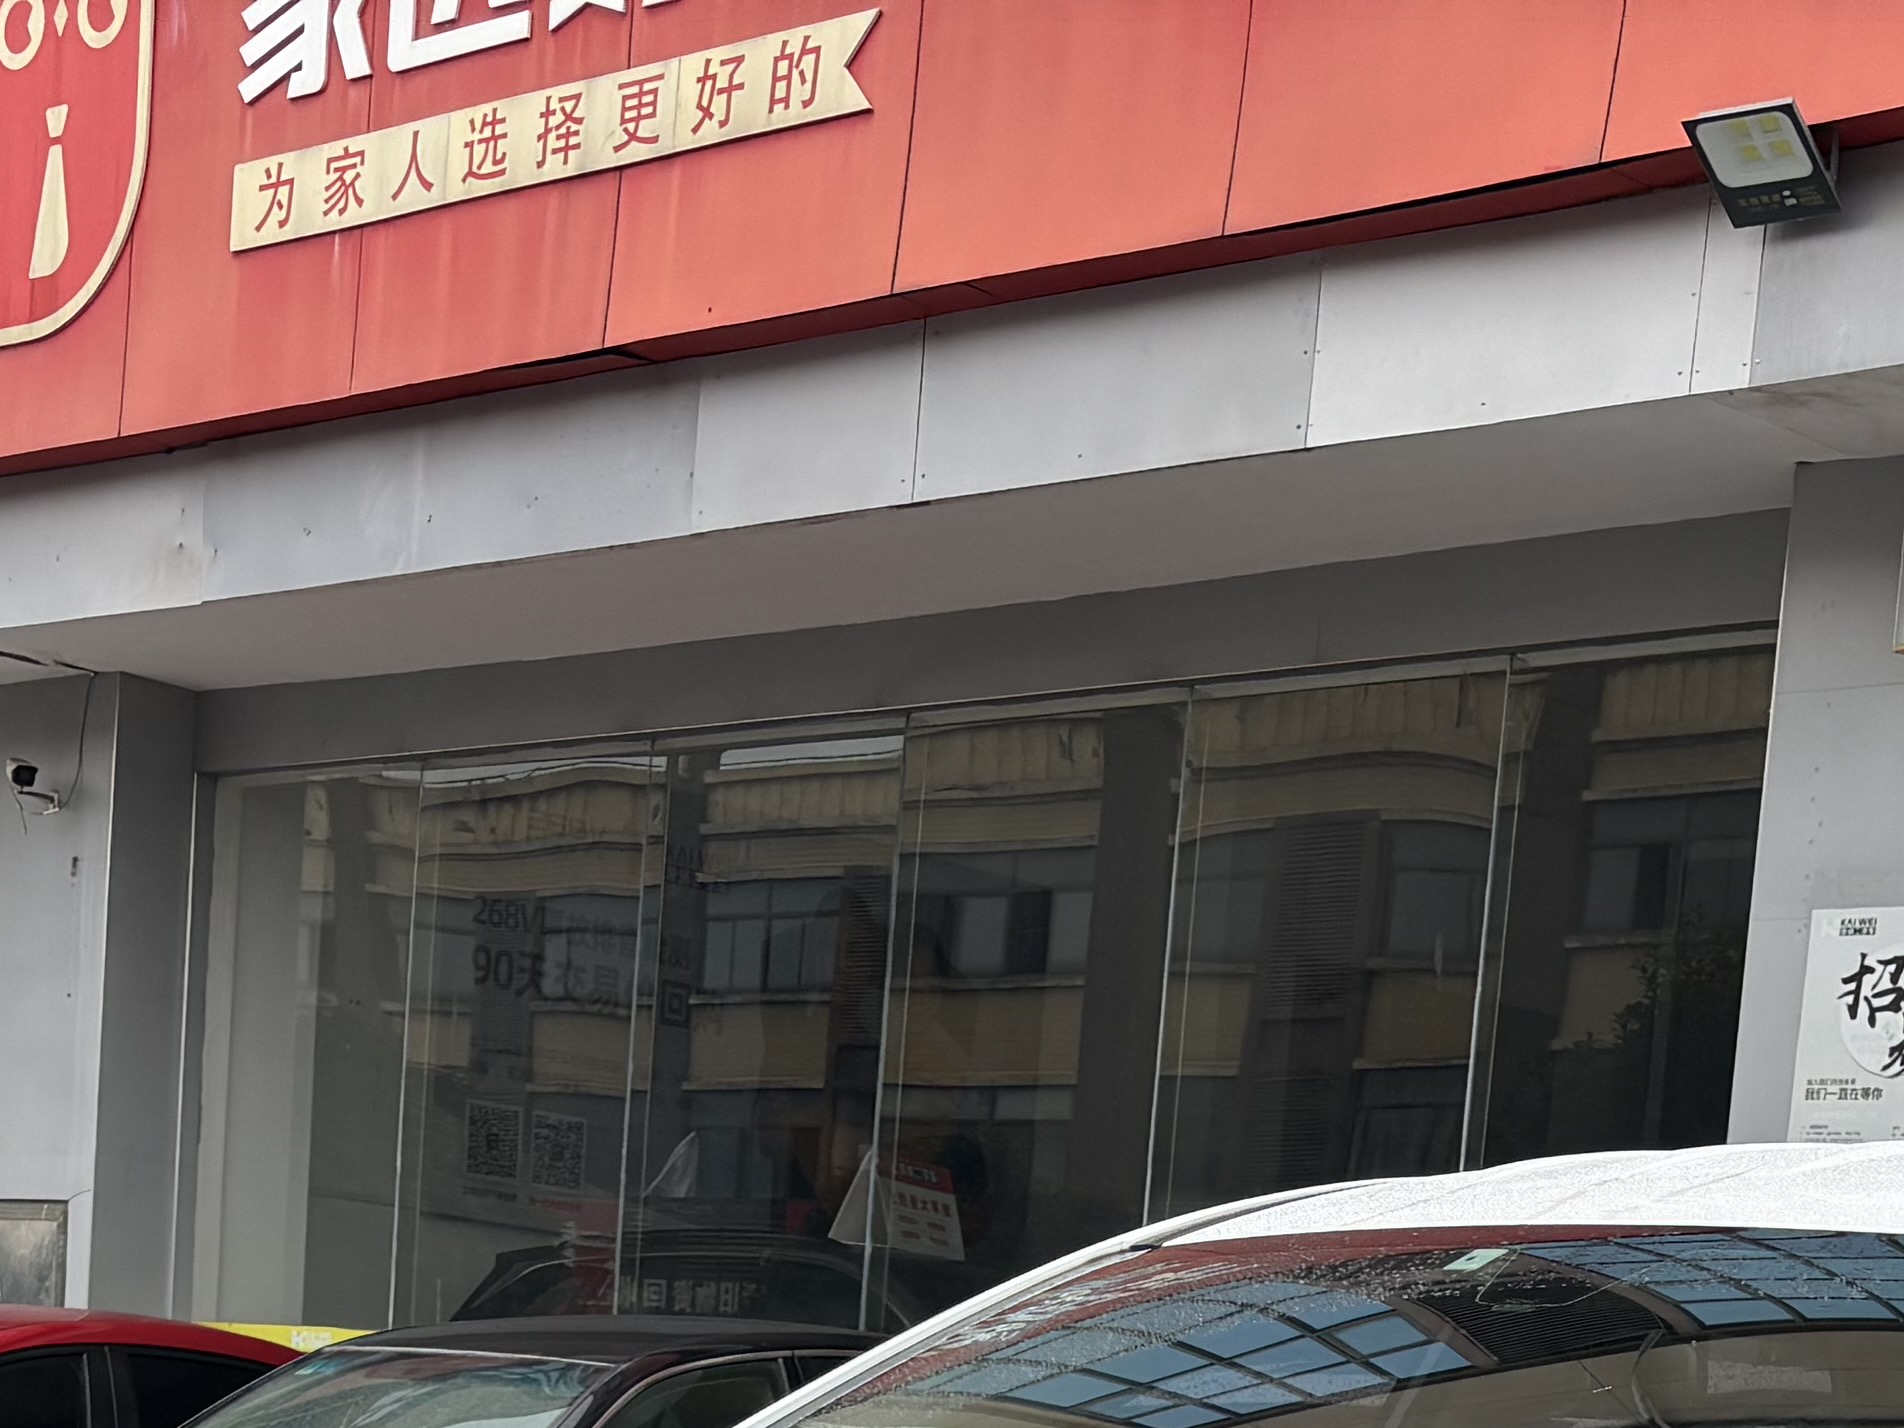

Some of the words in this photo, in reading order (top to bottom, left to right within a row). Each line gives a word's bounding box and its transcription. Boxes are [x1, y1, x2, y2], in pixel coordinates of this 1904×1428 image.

[254, 35, 821, 232] 为家人选择更好的
[1804, 1087, 1884, 1101] 我们一直在等你
